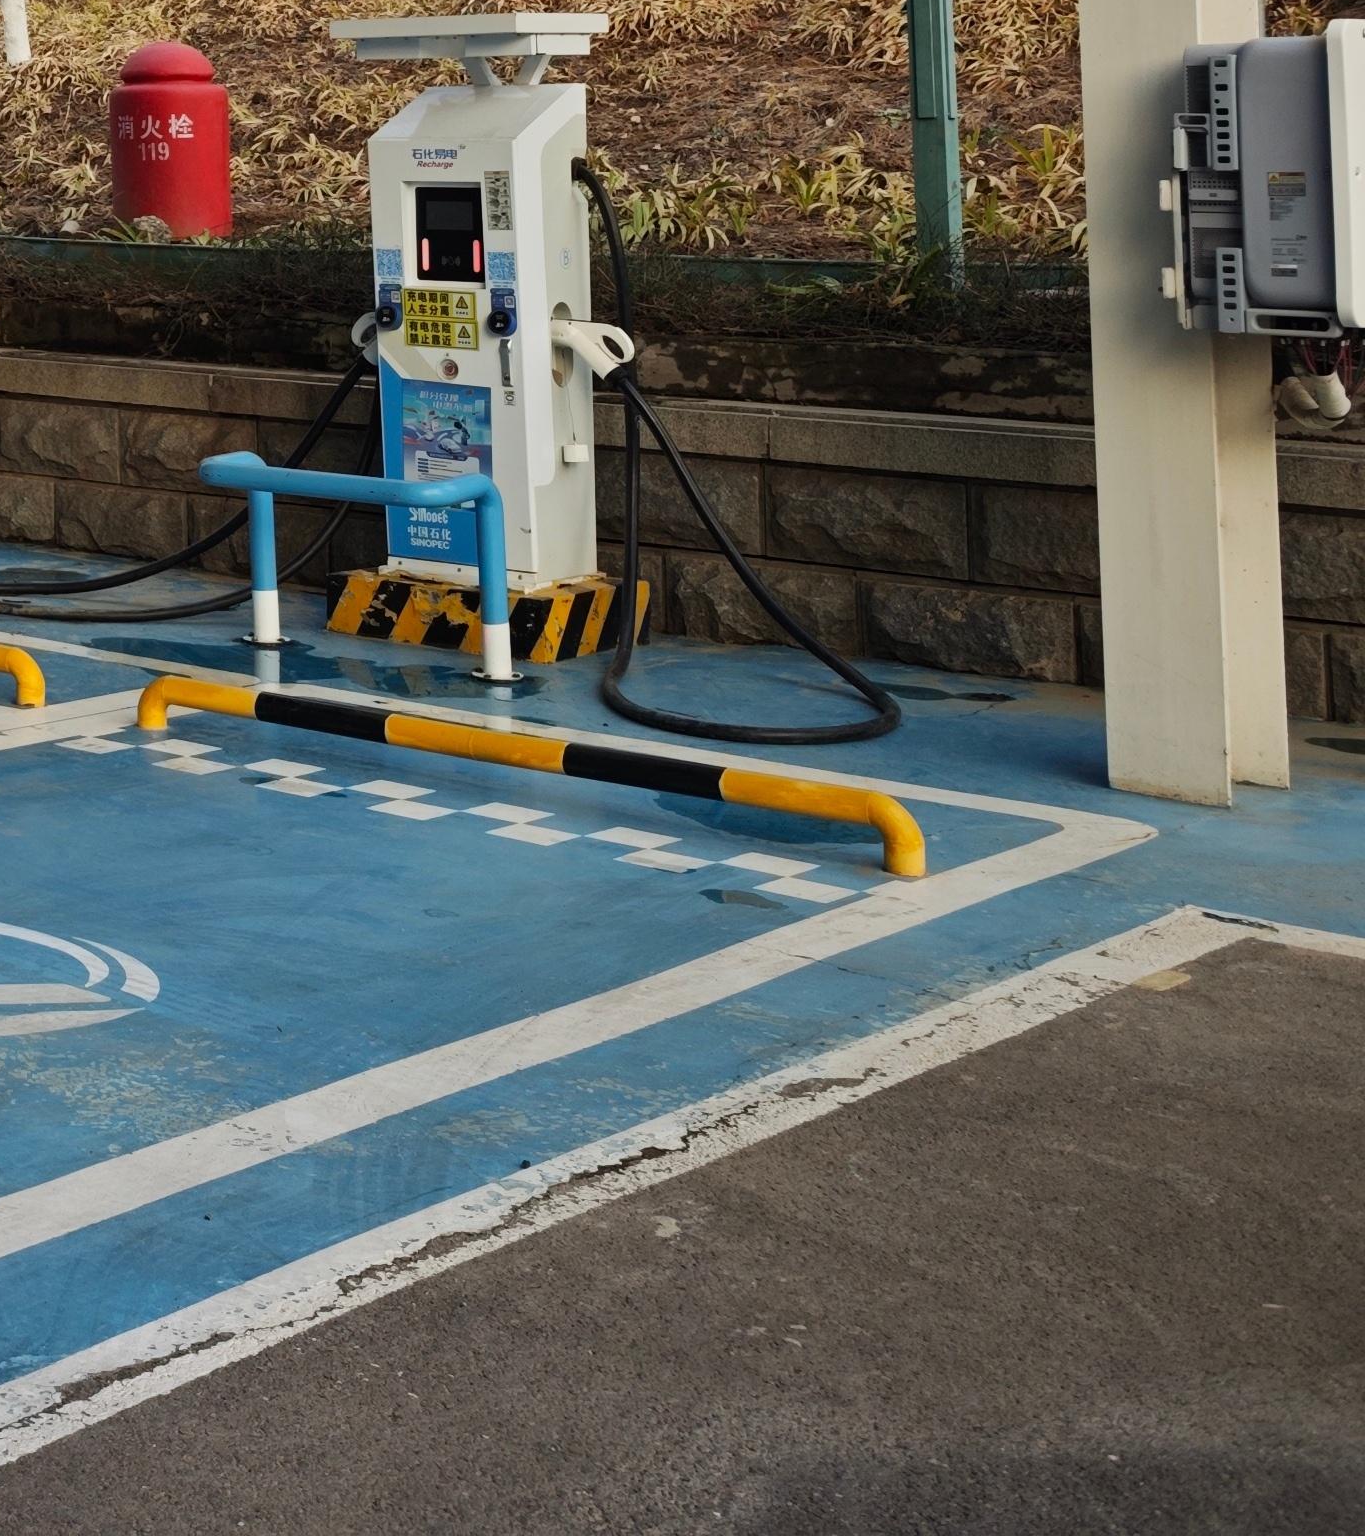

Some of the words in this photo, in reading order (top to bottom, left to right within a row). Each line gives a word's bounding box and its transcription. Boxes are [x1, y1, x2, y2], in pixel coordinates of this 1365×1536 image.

[118, 114, 194, 140] 消火栓
[139, 142, 170, 161] 119
[416, 160, 454, 169] Recharge
[407, 291, 449, 304] 充电期间
[407, 524, 452, 541] 中国石化
[410, 537, 450, 550] SINOPEC
